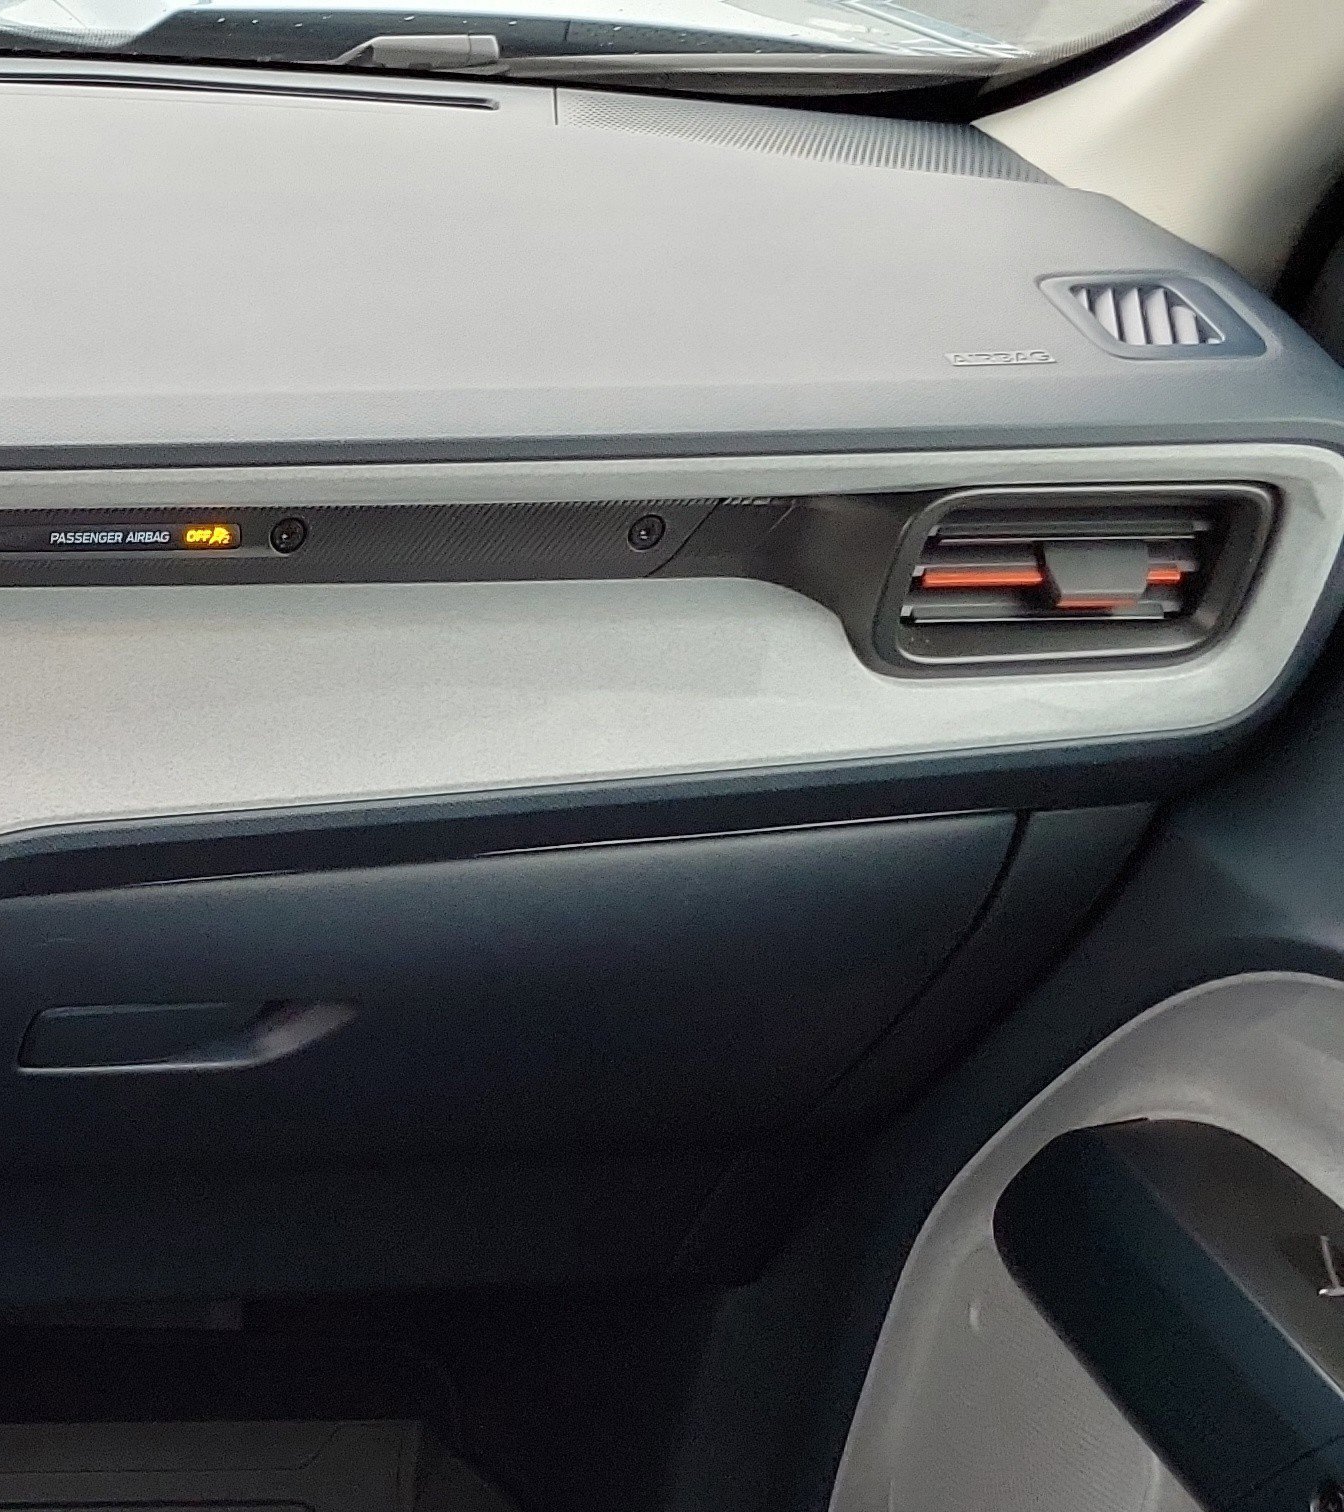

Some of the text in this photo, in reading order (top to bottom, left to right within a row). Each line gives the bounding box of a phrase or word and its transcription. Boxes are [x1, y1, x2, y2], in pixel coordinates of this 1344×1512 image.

[50, 529, 211, 544] PASSENGER AIRBAG OFF
